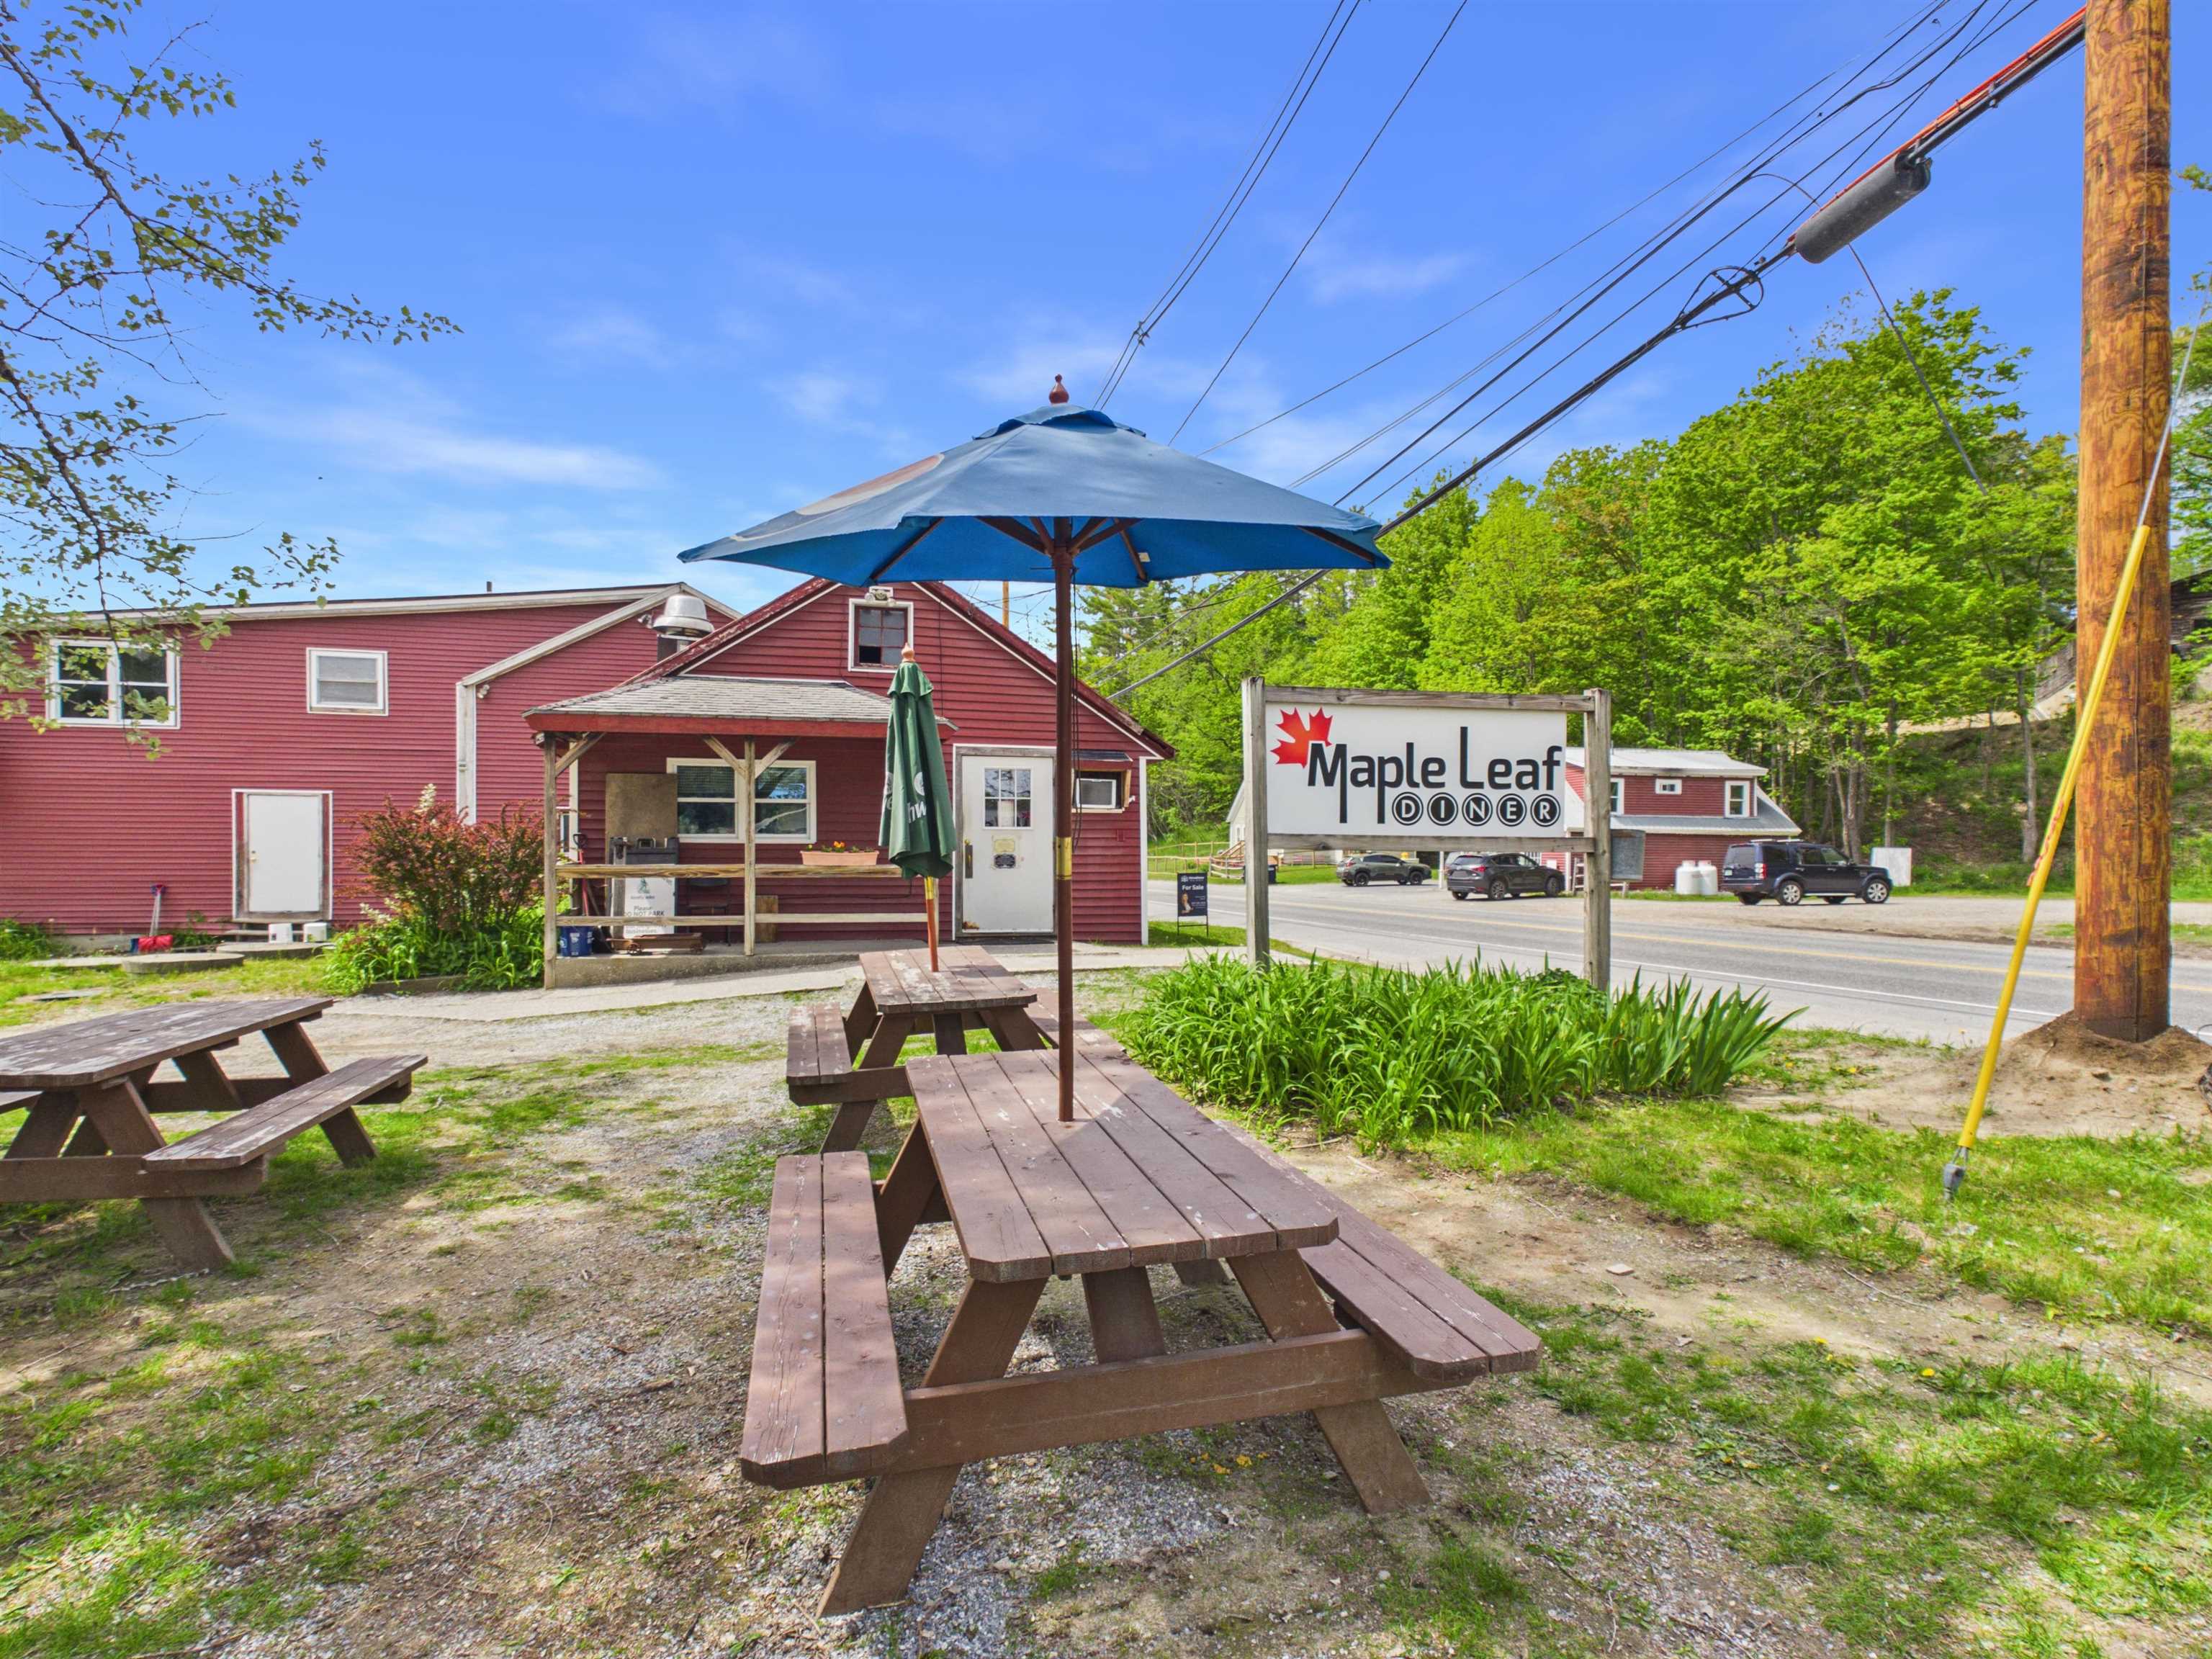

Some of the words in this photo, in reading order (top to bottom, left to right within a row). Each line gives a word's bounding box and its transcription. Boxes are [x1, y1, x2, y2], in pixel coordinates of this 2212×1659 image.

[1307, 742, 1446, 824] Maple
[1460, 727, 1563, 791] Leaf
[1395, 794, 1557, 824] DINER
